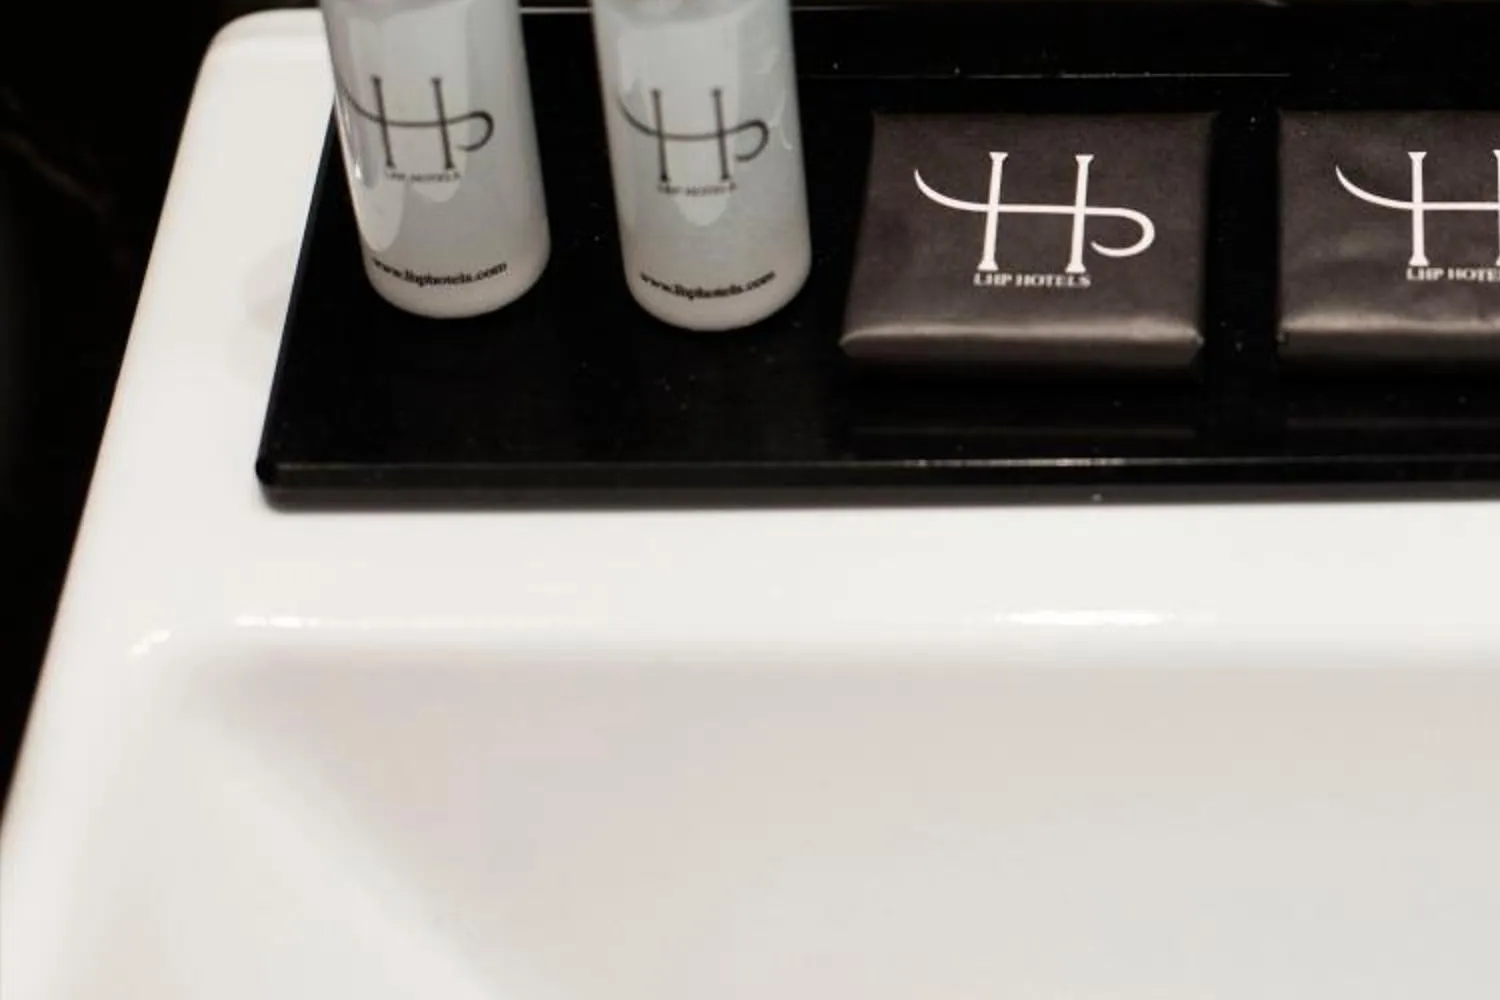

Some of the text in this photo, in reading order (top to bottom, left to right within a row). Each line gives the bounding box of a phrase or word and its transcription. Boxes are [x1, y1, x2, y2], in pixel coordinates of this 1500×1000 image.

[973, 272, 1091, 289] LHP HOTELS
[1406, 266, 1444, 281] LHP
